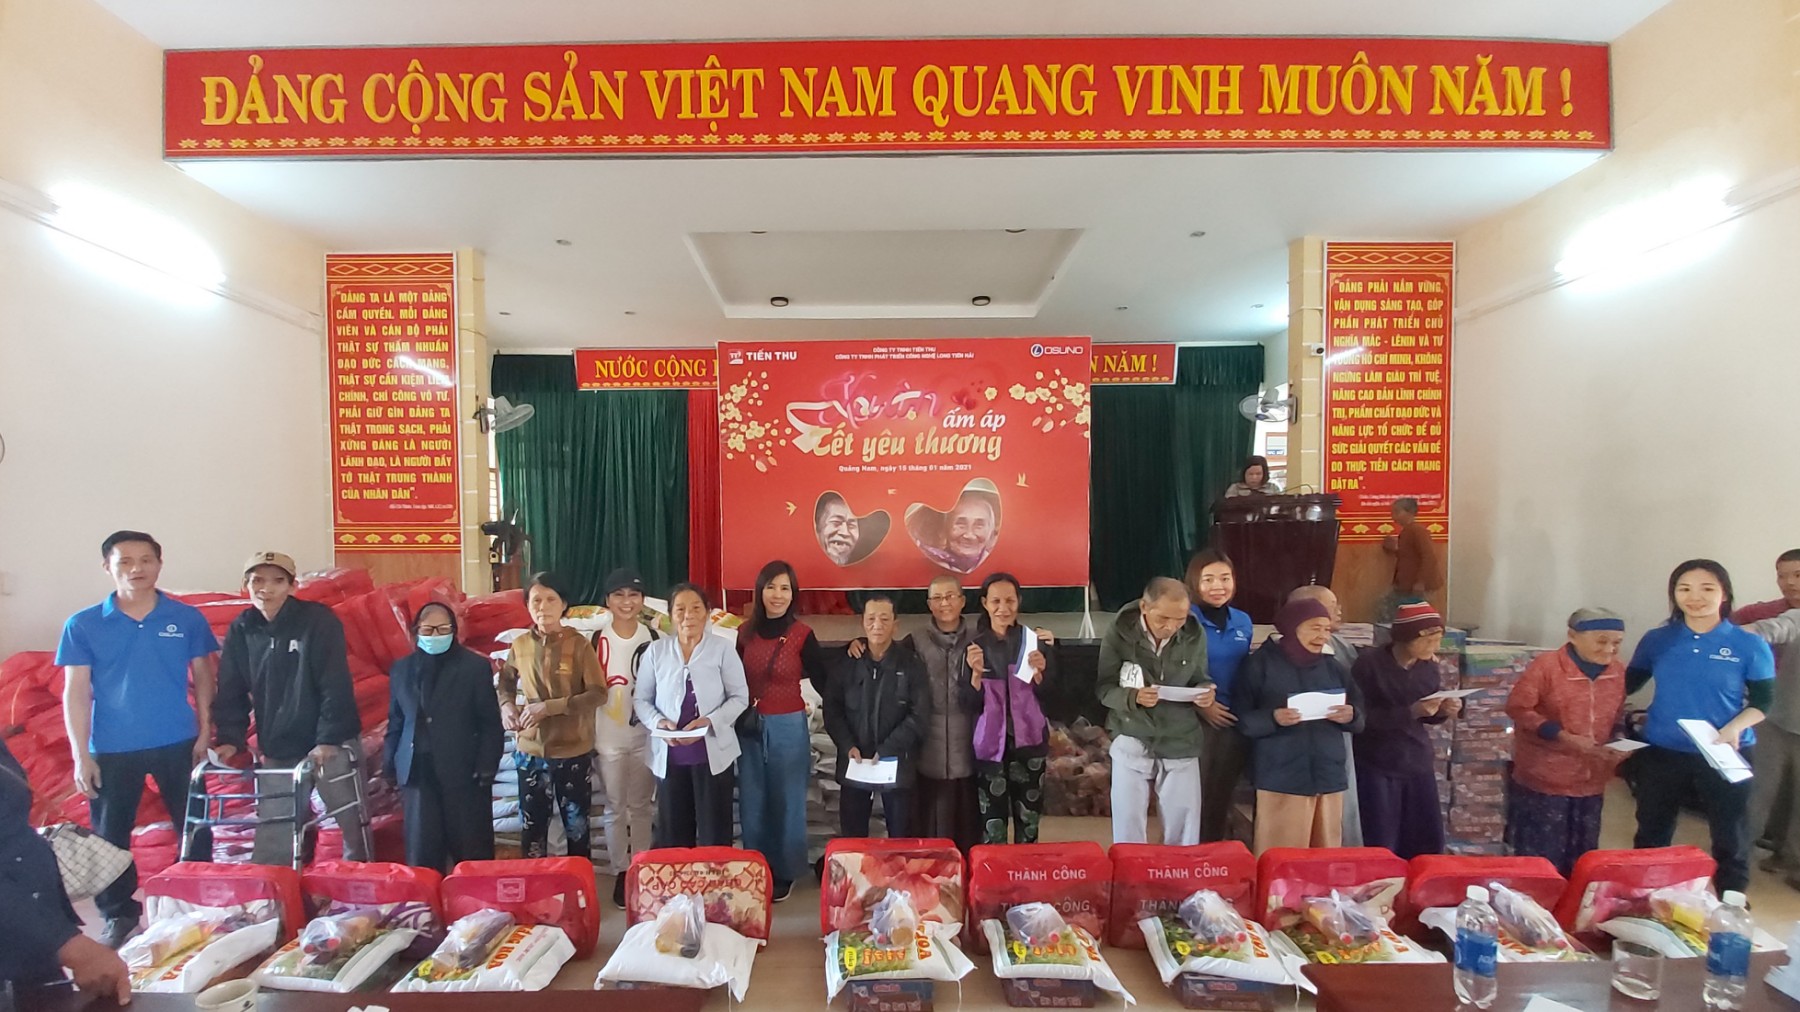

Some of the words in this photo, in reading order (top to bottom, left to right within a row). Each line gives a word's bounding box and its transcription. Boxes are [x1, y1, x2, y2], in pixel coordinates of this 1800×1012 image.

[200, 54, 348, 125] ĐẢNG
[362, 58, 507, 134] CỘNG
[523, 50, 628, 123] SẢN
[640, 54, 765, 132] VIỆT
[779, 65, 897, 118] NAM
[912, 63, 1098, 128] QUANG
[1112, 64, 1245, 117] VINH
[1257, 50, 1418, 117] MUÔN
[1428, 53, 1548, 117] NĂM
[1559, 67, 1574, 118] !
[369, 292, 380, 303] TA
[1432, 336, 1445, 347] TƯ
[774, 351, 797, 360] THU
[1044, 346, 1083, 355] OSUNO
[1103, 350, 1147, 373] NĂM
[594, 354, 649, 379] NƯỚC
[653, 354, 707, 382] CỘNG
[1358, 390, 1375, 401] CAO
[440, 408, 451, 418] TA
[943, 407, 975, 429] ấm
[980, 408, 1006, 431] áp
[366, 424, 395, 435] TRONG
[862, 428, 905, 462] yêu
[914, 426, 1002, 461] thương
[1330, 460, 1343, 472] DO
[386, 472, 417, 484] TRUNG
[1007, 866, 1048, 881] THÀNH
[1052, 864, 1087, 881] CÔNG
[1147, 866, 1190, 880] THÀNH
[1194, 862, 1229, 878] CÔNG
